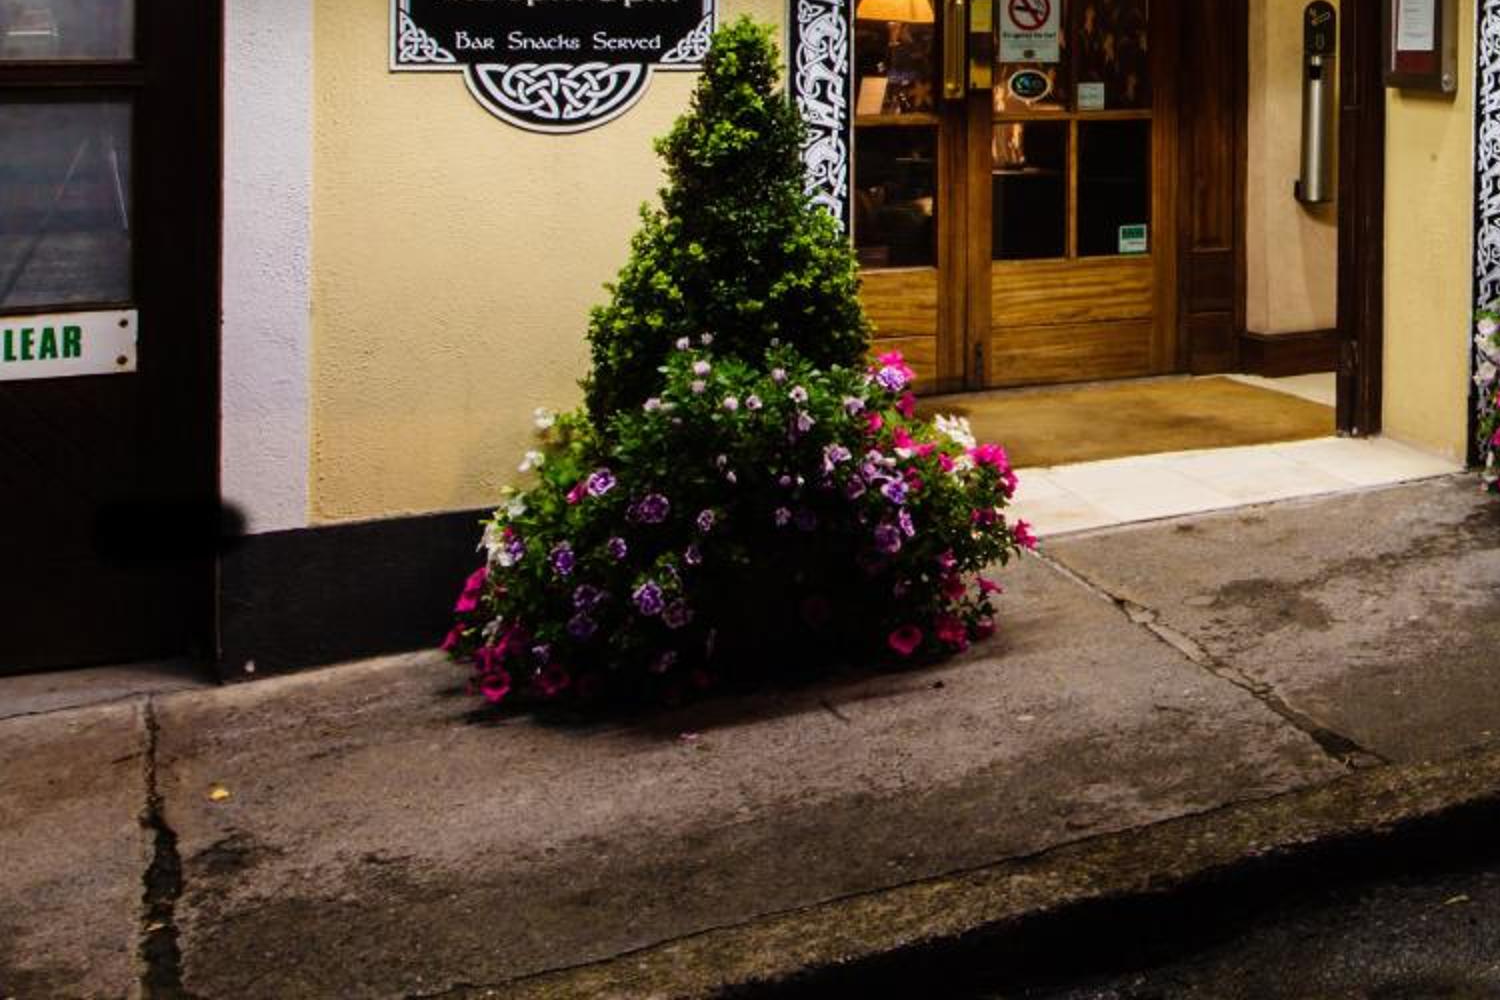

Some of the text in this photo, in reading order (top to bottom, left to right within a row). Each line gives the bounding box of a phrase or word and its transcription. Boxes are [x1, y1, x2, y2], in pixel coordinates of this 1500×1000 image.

[455, 32, 661, 51] Bar Snacks Served
